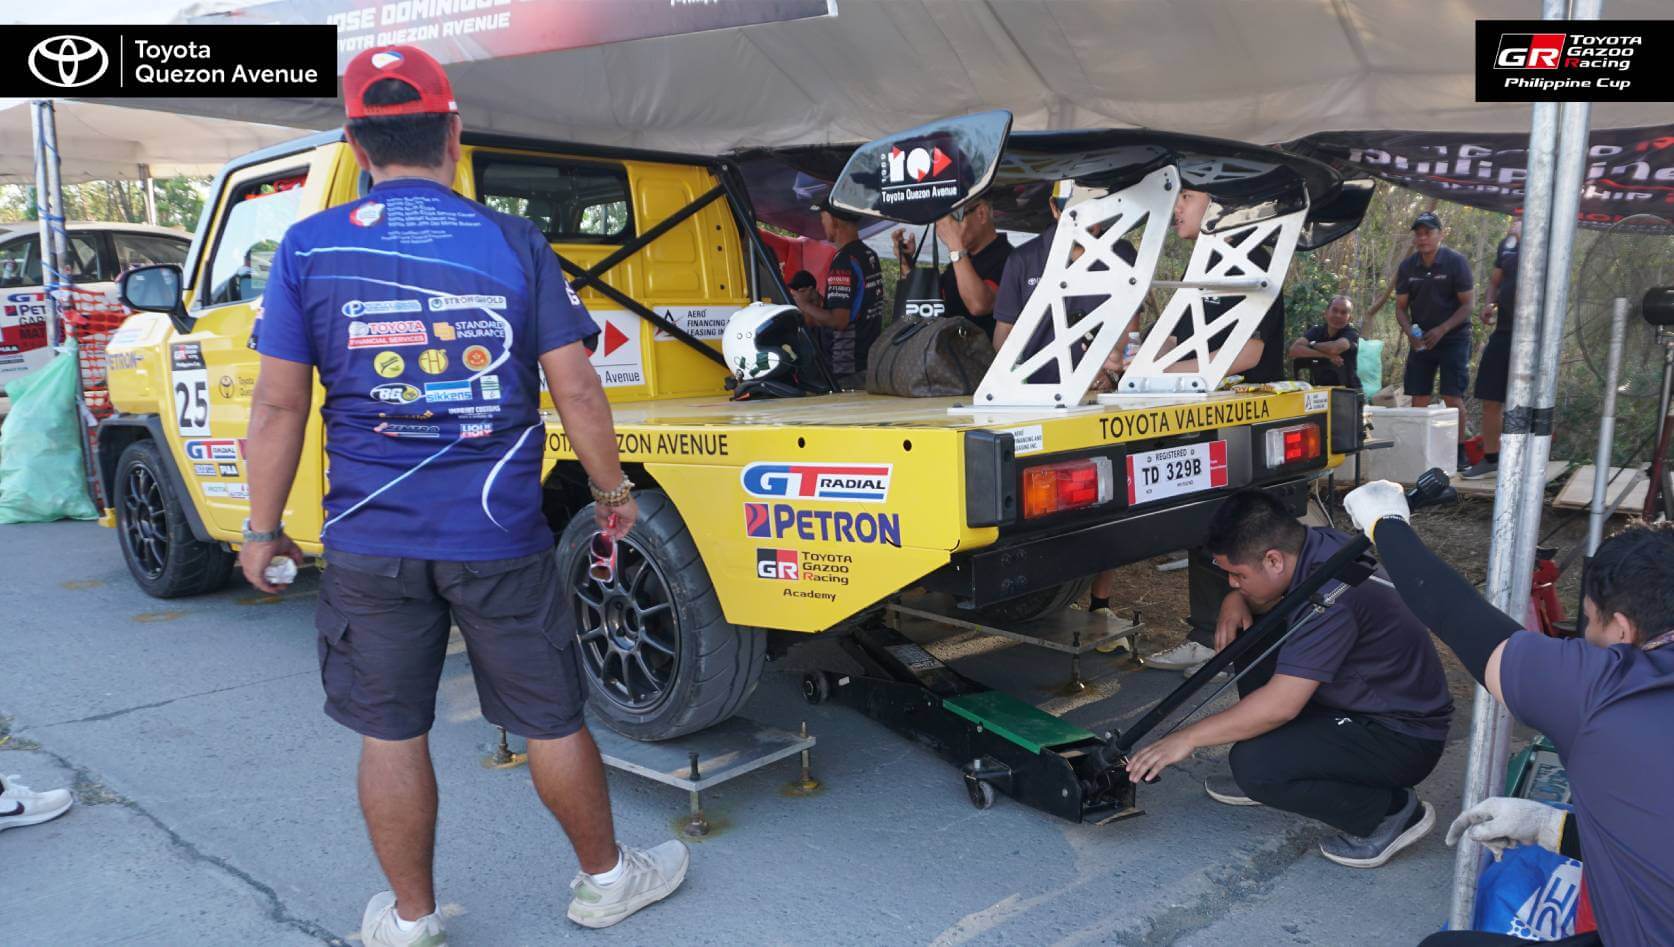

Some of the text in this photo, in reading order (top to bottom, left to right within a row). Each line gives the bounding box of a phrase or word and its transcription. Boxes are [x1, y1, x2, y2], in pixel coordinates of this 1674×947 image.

[381, 0, 509, 26] DOMINI
[338, 12, 511, 52] YOTA QUEZON AVENUE
[881, 186, 957, 203] Toyota Quezon Avenue
[687, 310, 706, 318] AERO
[905, 304, 945, 317] POP
[370, 322, 425, 335] TOYOTA
[456, 321, 504, 330] STANDARD
[457, 329, 505, 339] INSURANCE
[605, 370, 640, 384] Avenue
[427, 391, 472, 401] sikkens
[175, 381, 208, 428] 25
[1098, 399, 1270, 440] TOYOTA VALENZUELA
[616, 433, 652, 454] ZON
[657, 434, 729, 456] AVENUE
[1155, 448, 1188, 462] REGISTERED
[1142, 458, 1202, 486] TD 329B
[820, 478, 886, 490] RADIAL
[773, 504, 902, 545] PETRON
[802, 551, 853, 563] TOYOTA
[758, 560, 798, 580] GR
[802, 562, 849, 574] GAZOO
[803, 572, 849, 586] Racing
[783, 588, 837, 602] Academy
